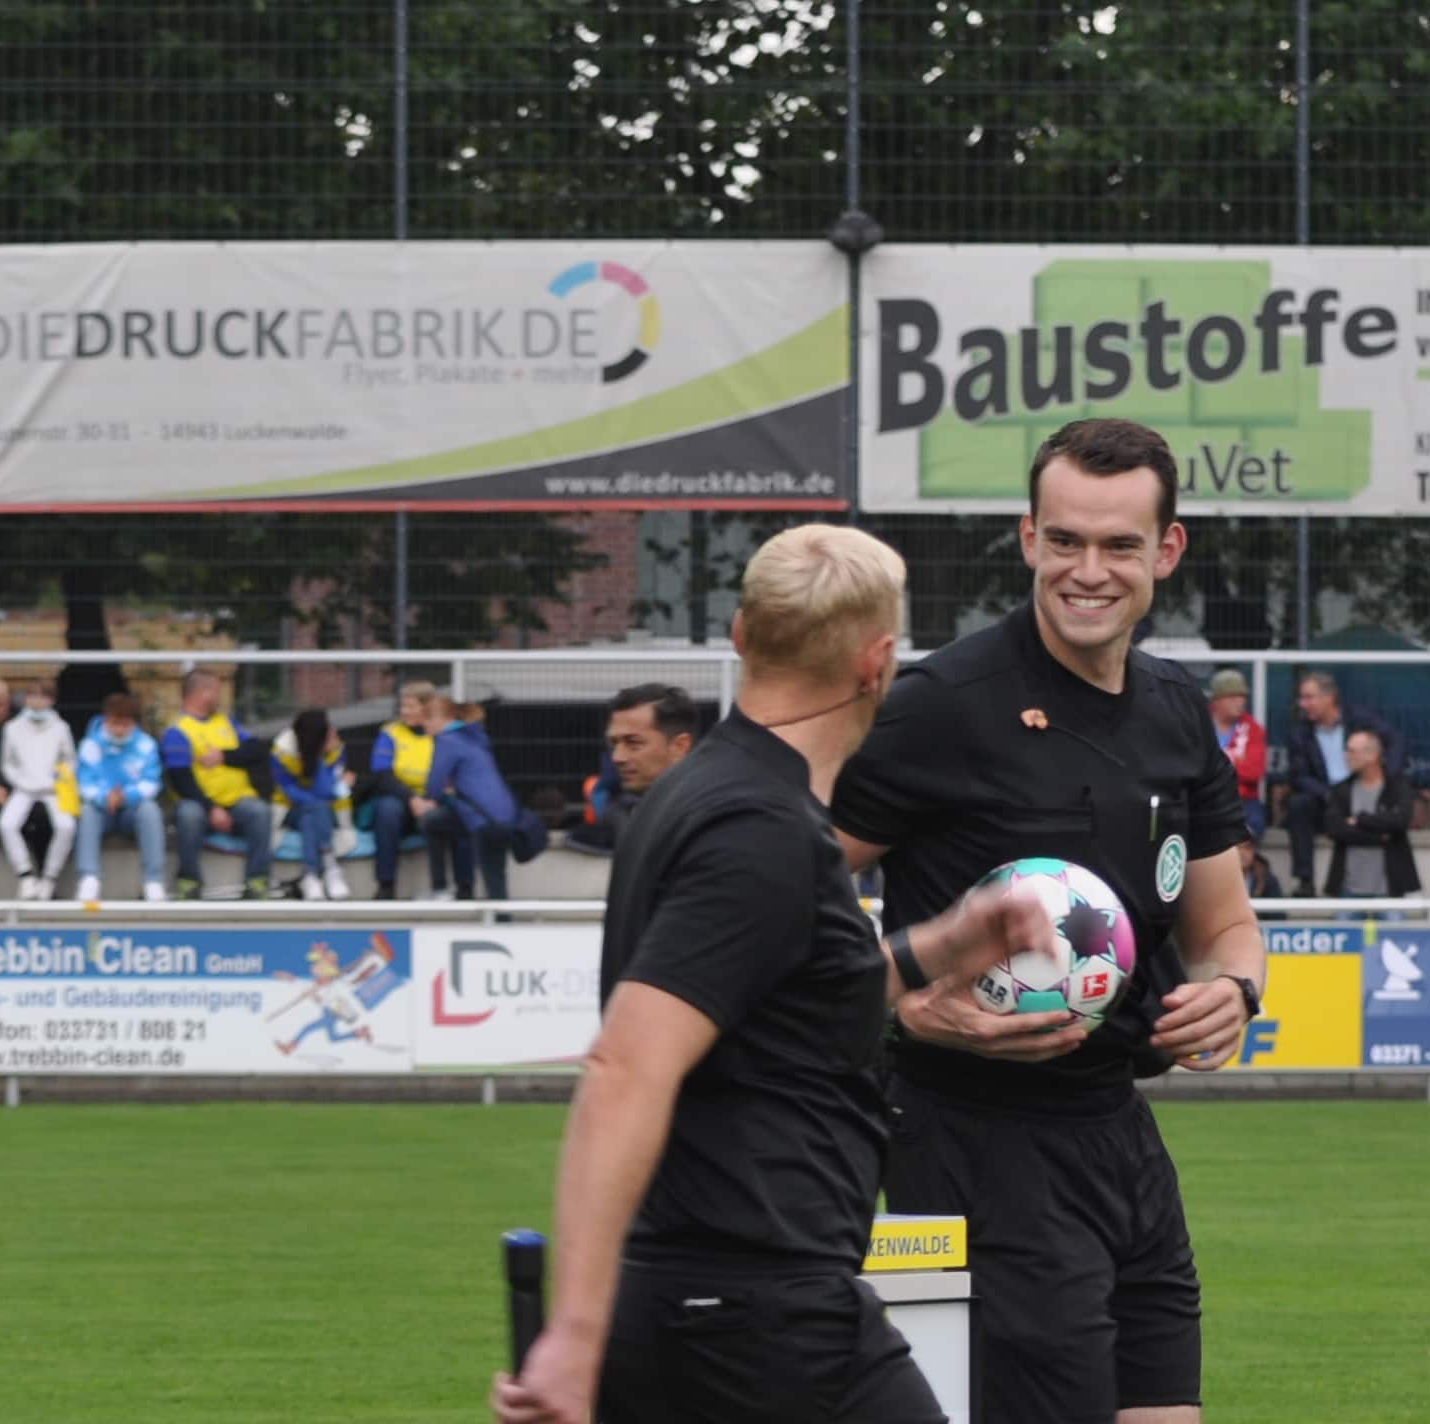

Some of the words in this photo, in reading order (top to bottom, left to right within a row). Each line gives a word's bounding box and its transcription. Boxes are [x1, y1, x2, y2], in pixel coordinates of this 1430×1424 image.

[876, 288, 1398, 436] Baustoffe
[544, 471, 836, 496] www.diedruckfabrik.de
[94, 935, 197, 976] Clean
[204, 954, 264, 975] GmbH
[15, 986, 57, 1009] und
[63, 986, 264, 1013] Gebäudereinigung
